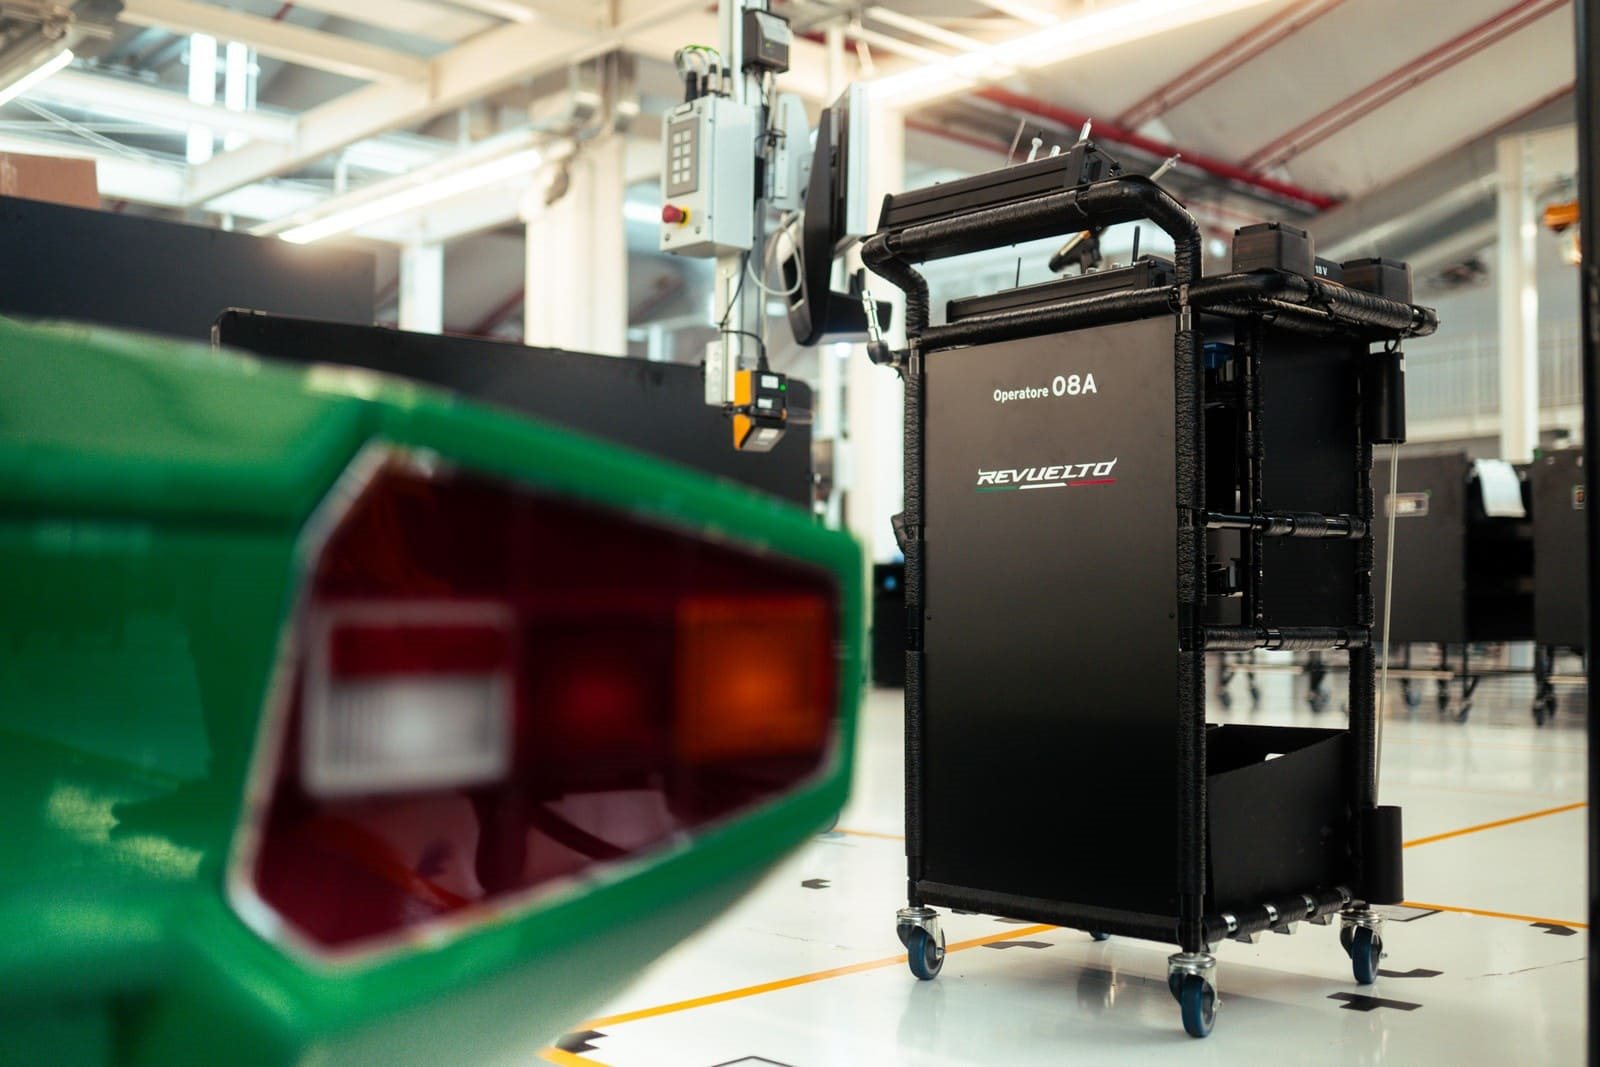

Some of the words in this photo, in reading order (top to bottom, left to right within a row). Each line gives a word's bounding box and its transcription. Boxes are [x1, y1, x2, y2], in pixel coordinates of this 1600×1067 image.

[993, 386, 1049, 404] Operatore
[1052, 373, 1097, 397] 08A
[977, 457, 1118, 485] REVUELTO
